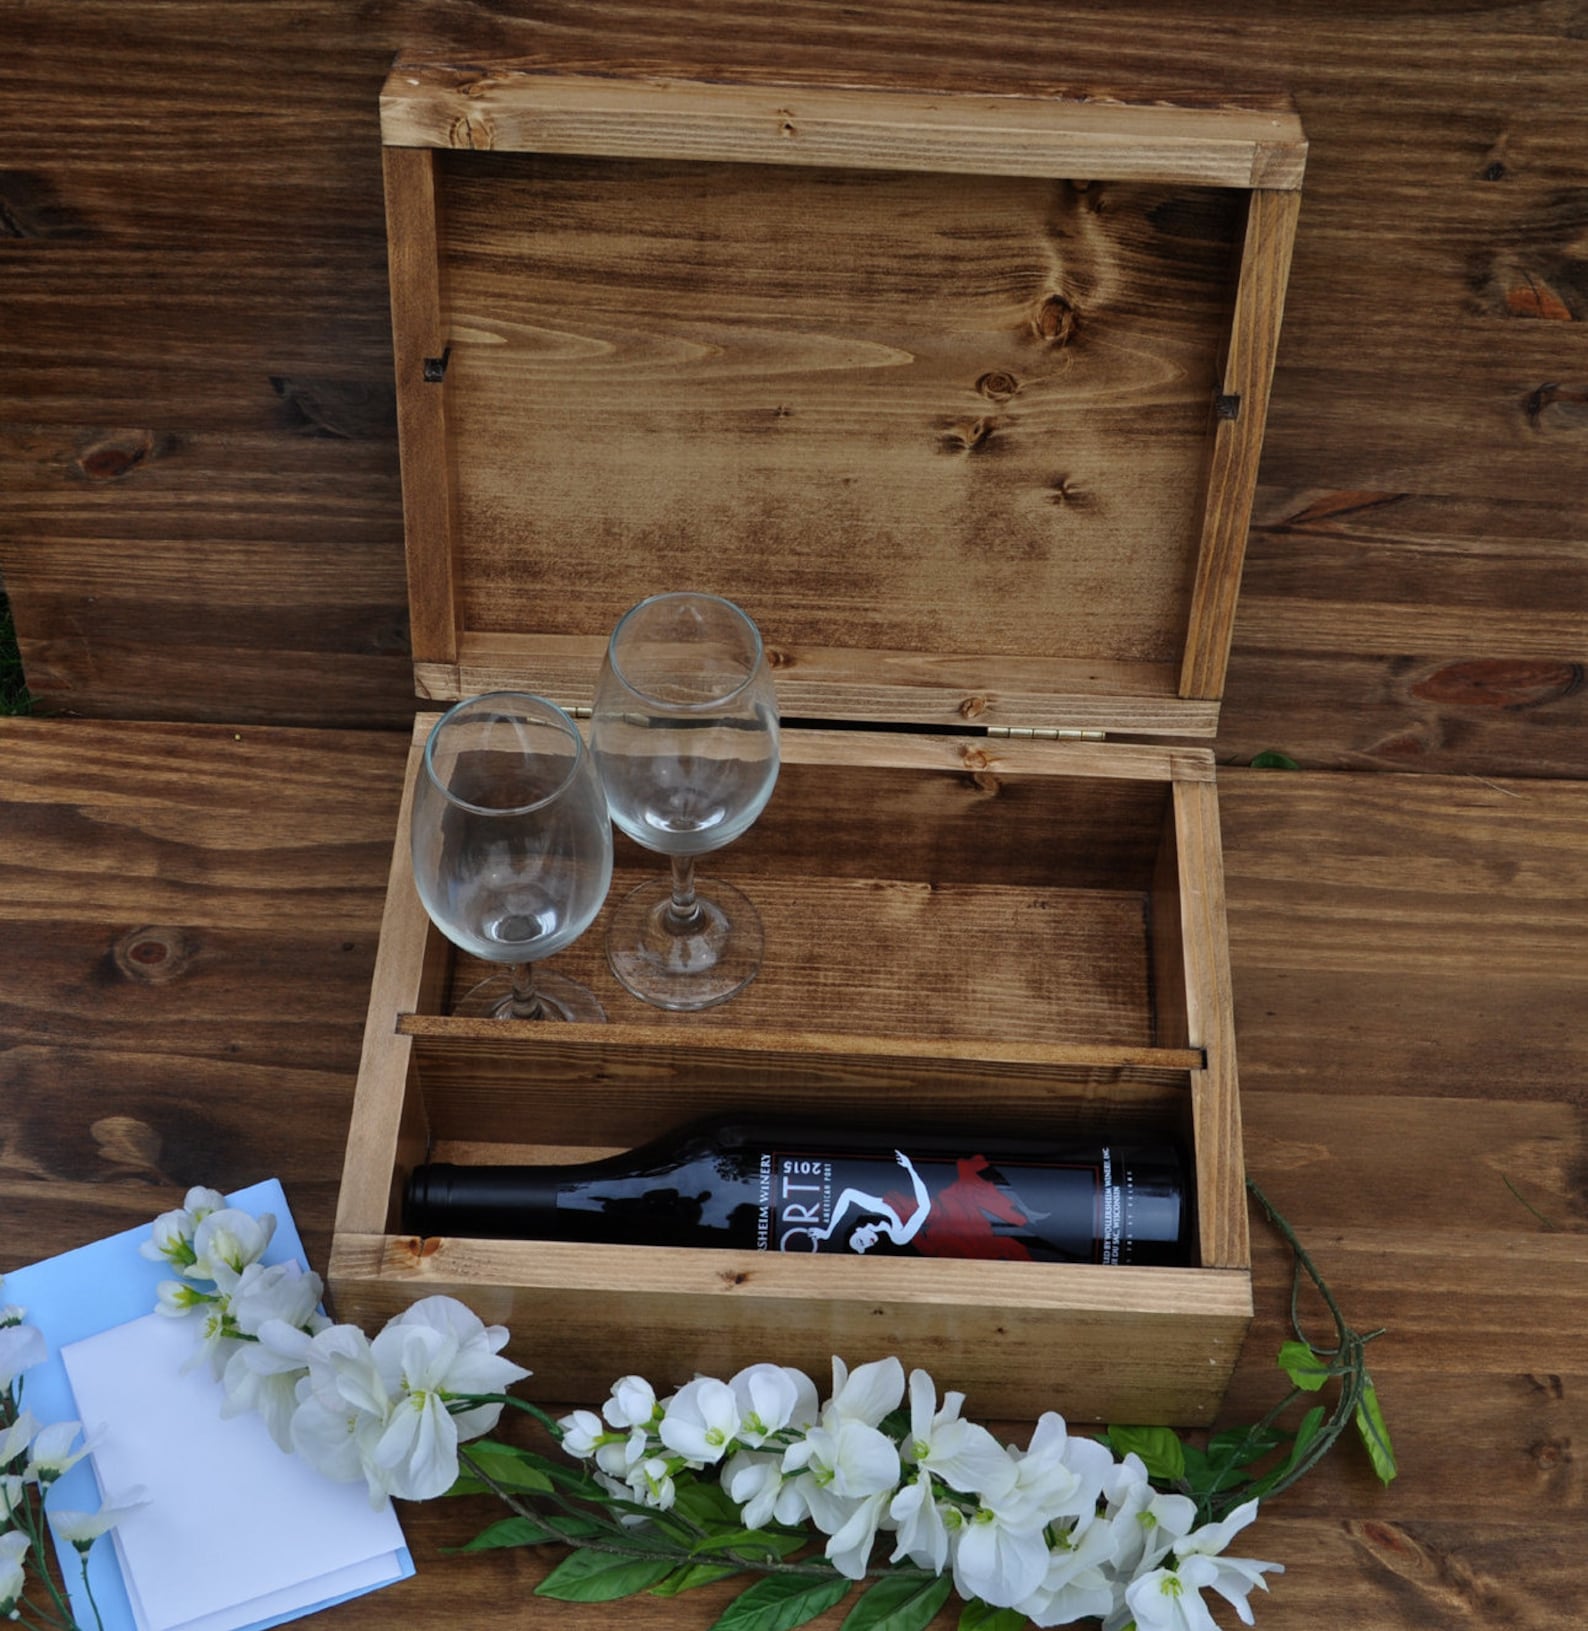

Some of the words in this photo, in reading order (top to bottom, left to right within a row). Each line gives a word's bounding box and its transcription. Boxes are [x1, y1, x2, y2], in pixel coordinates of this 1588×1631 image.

[759, 1153, 772, 1203] WINERY
[783, 1161, 822, 1175] 2015
[824, 1163, 832, 1182] PORT
[823, 1185, 831, 1223] AMERICAN
[1104, 1188, 1113, 1240] WOLLERSHEIM
[1112, 1186, 1120, 1229] WISCONSIN
